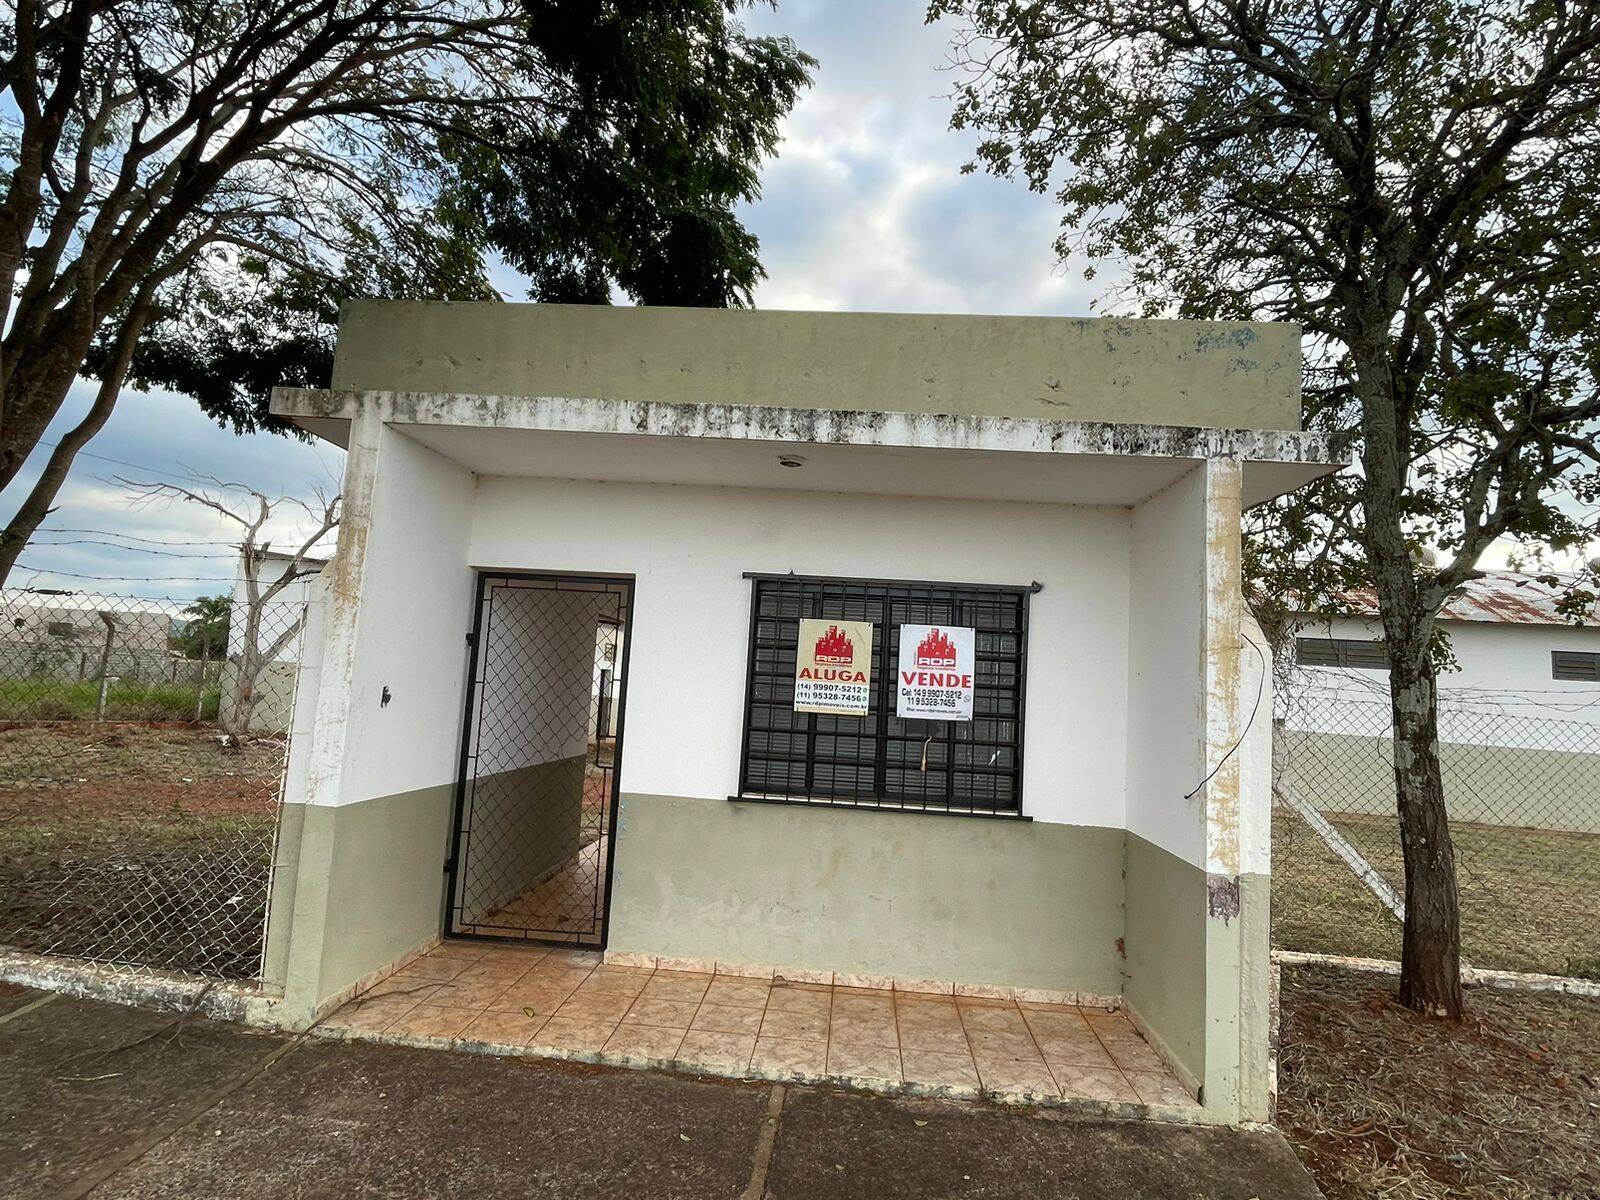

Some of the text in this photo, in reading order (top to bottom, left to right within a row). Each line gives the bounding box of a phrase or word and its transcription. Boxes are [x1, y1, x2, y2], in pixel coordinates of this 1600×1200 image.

[815, 654, 852, 663] RDP
[918, 657, 955, 666] RDP
[799, 668, 867, 682] ALUGA
[902, 671, 971, 688] VENDE
[797, 683, 862, 693] (14) 99907-5212
[812, 692, 862, 702] 95328-7456
[795, 700, 867, 709] www.rdpimoveis.com.br
